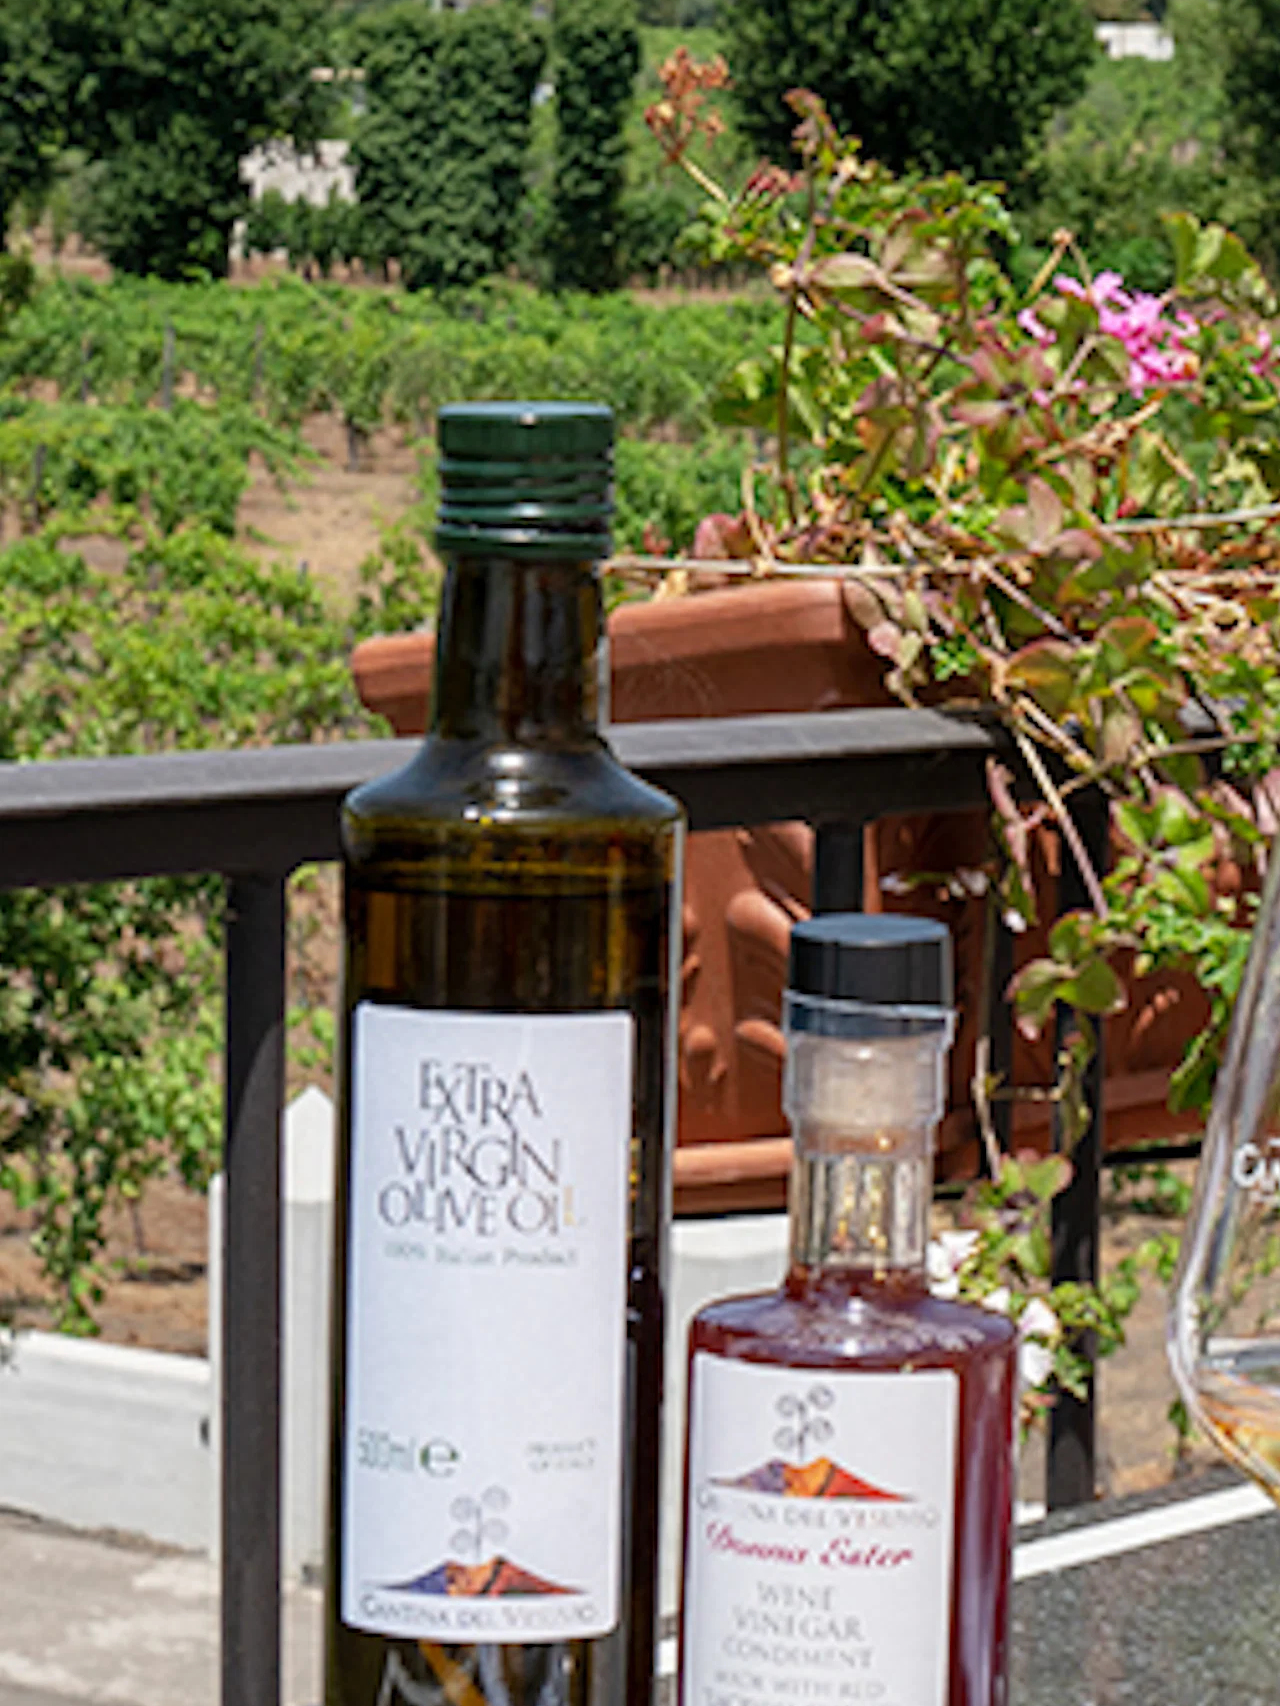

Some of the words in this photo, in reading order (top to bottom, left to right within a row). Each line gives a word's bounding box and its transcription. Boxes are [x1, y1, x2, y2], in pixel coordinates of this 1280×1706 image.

[419, 1059, 543, 1125] EXTRA
[394, 1125, 561, 1188] VIRGIN
[378, 1181, 497, 1236] OLIVE
[506, 1186, 578, 1236] OIL
[706, 1520, 809, 1565] Donna
[818, 1536, 914, 1566] Ester
[359, 1595, 448, 1624] CANTINA
[459, 1608, 499, 1628] DEL
[502, 1603, 596, 1629] VESUVIO
[757, 1581, 835, 1611] WINE
[733, 1605, 867, 1643] VINEGAR
